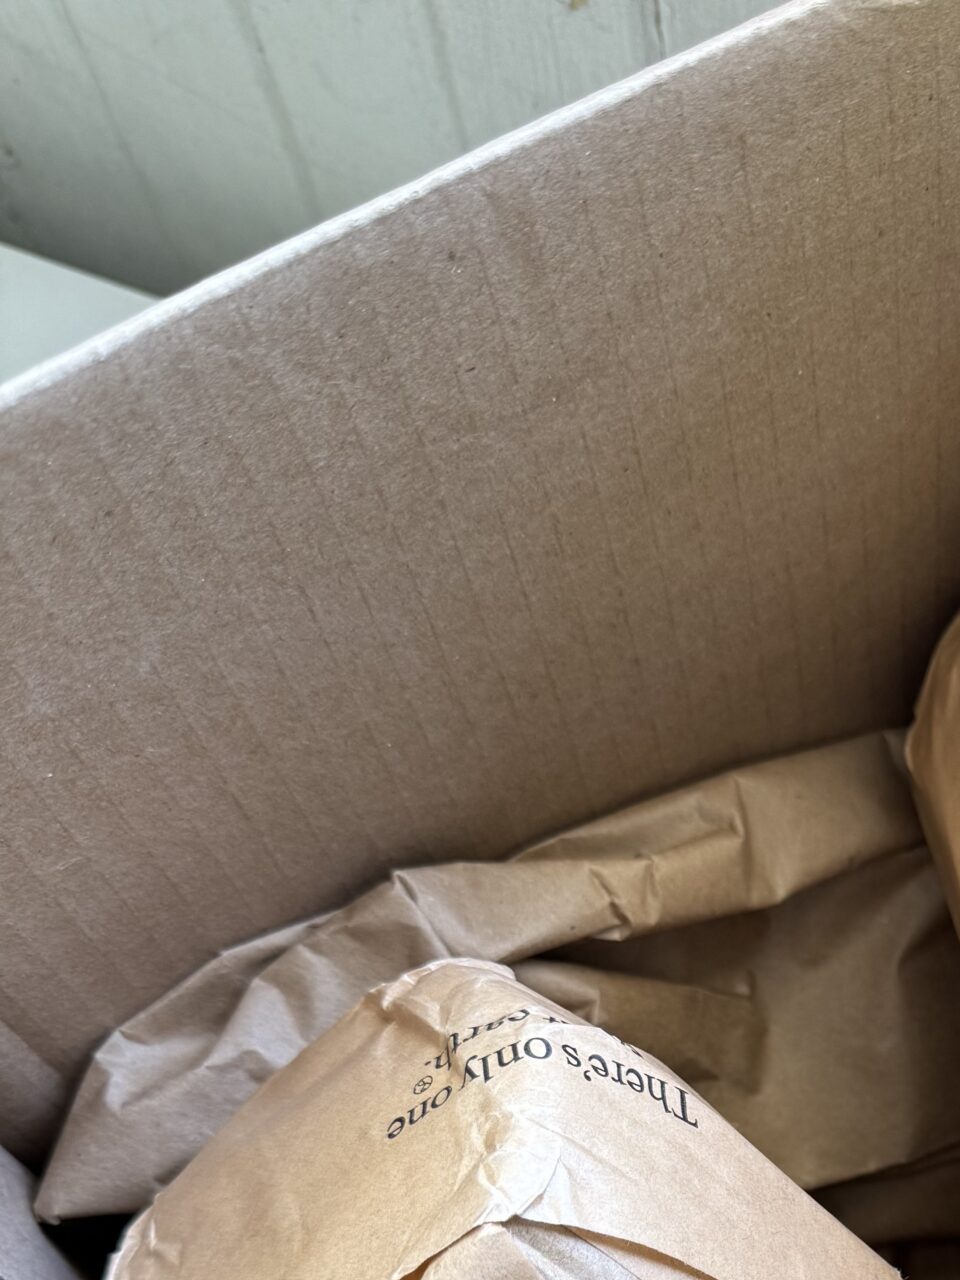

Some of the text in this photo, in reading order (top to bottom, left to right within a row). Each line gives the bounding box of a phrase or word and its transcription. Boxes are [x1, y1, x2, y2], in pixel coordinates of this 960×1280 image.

[460, 1037, 553, 1091] only
[561, 1043, 698, 1128] There's
[387, 1085, 452, 1139] one
